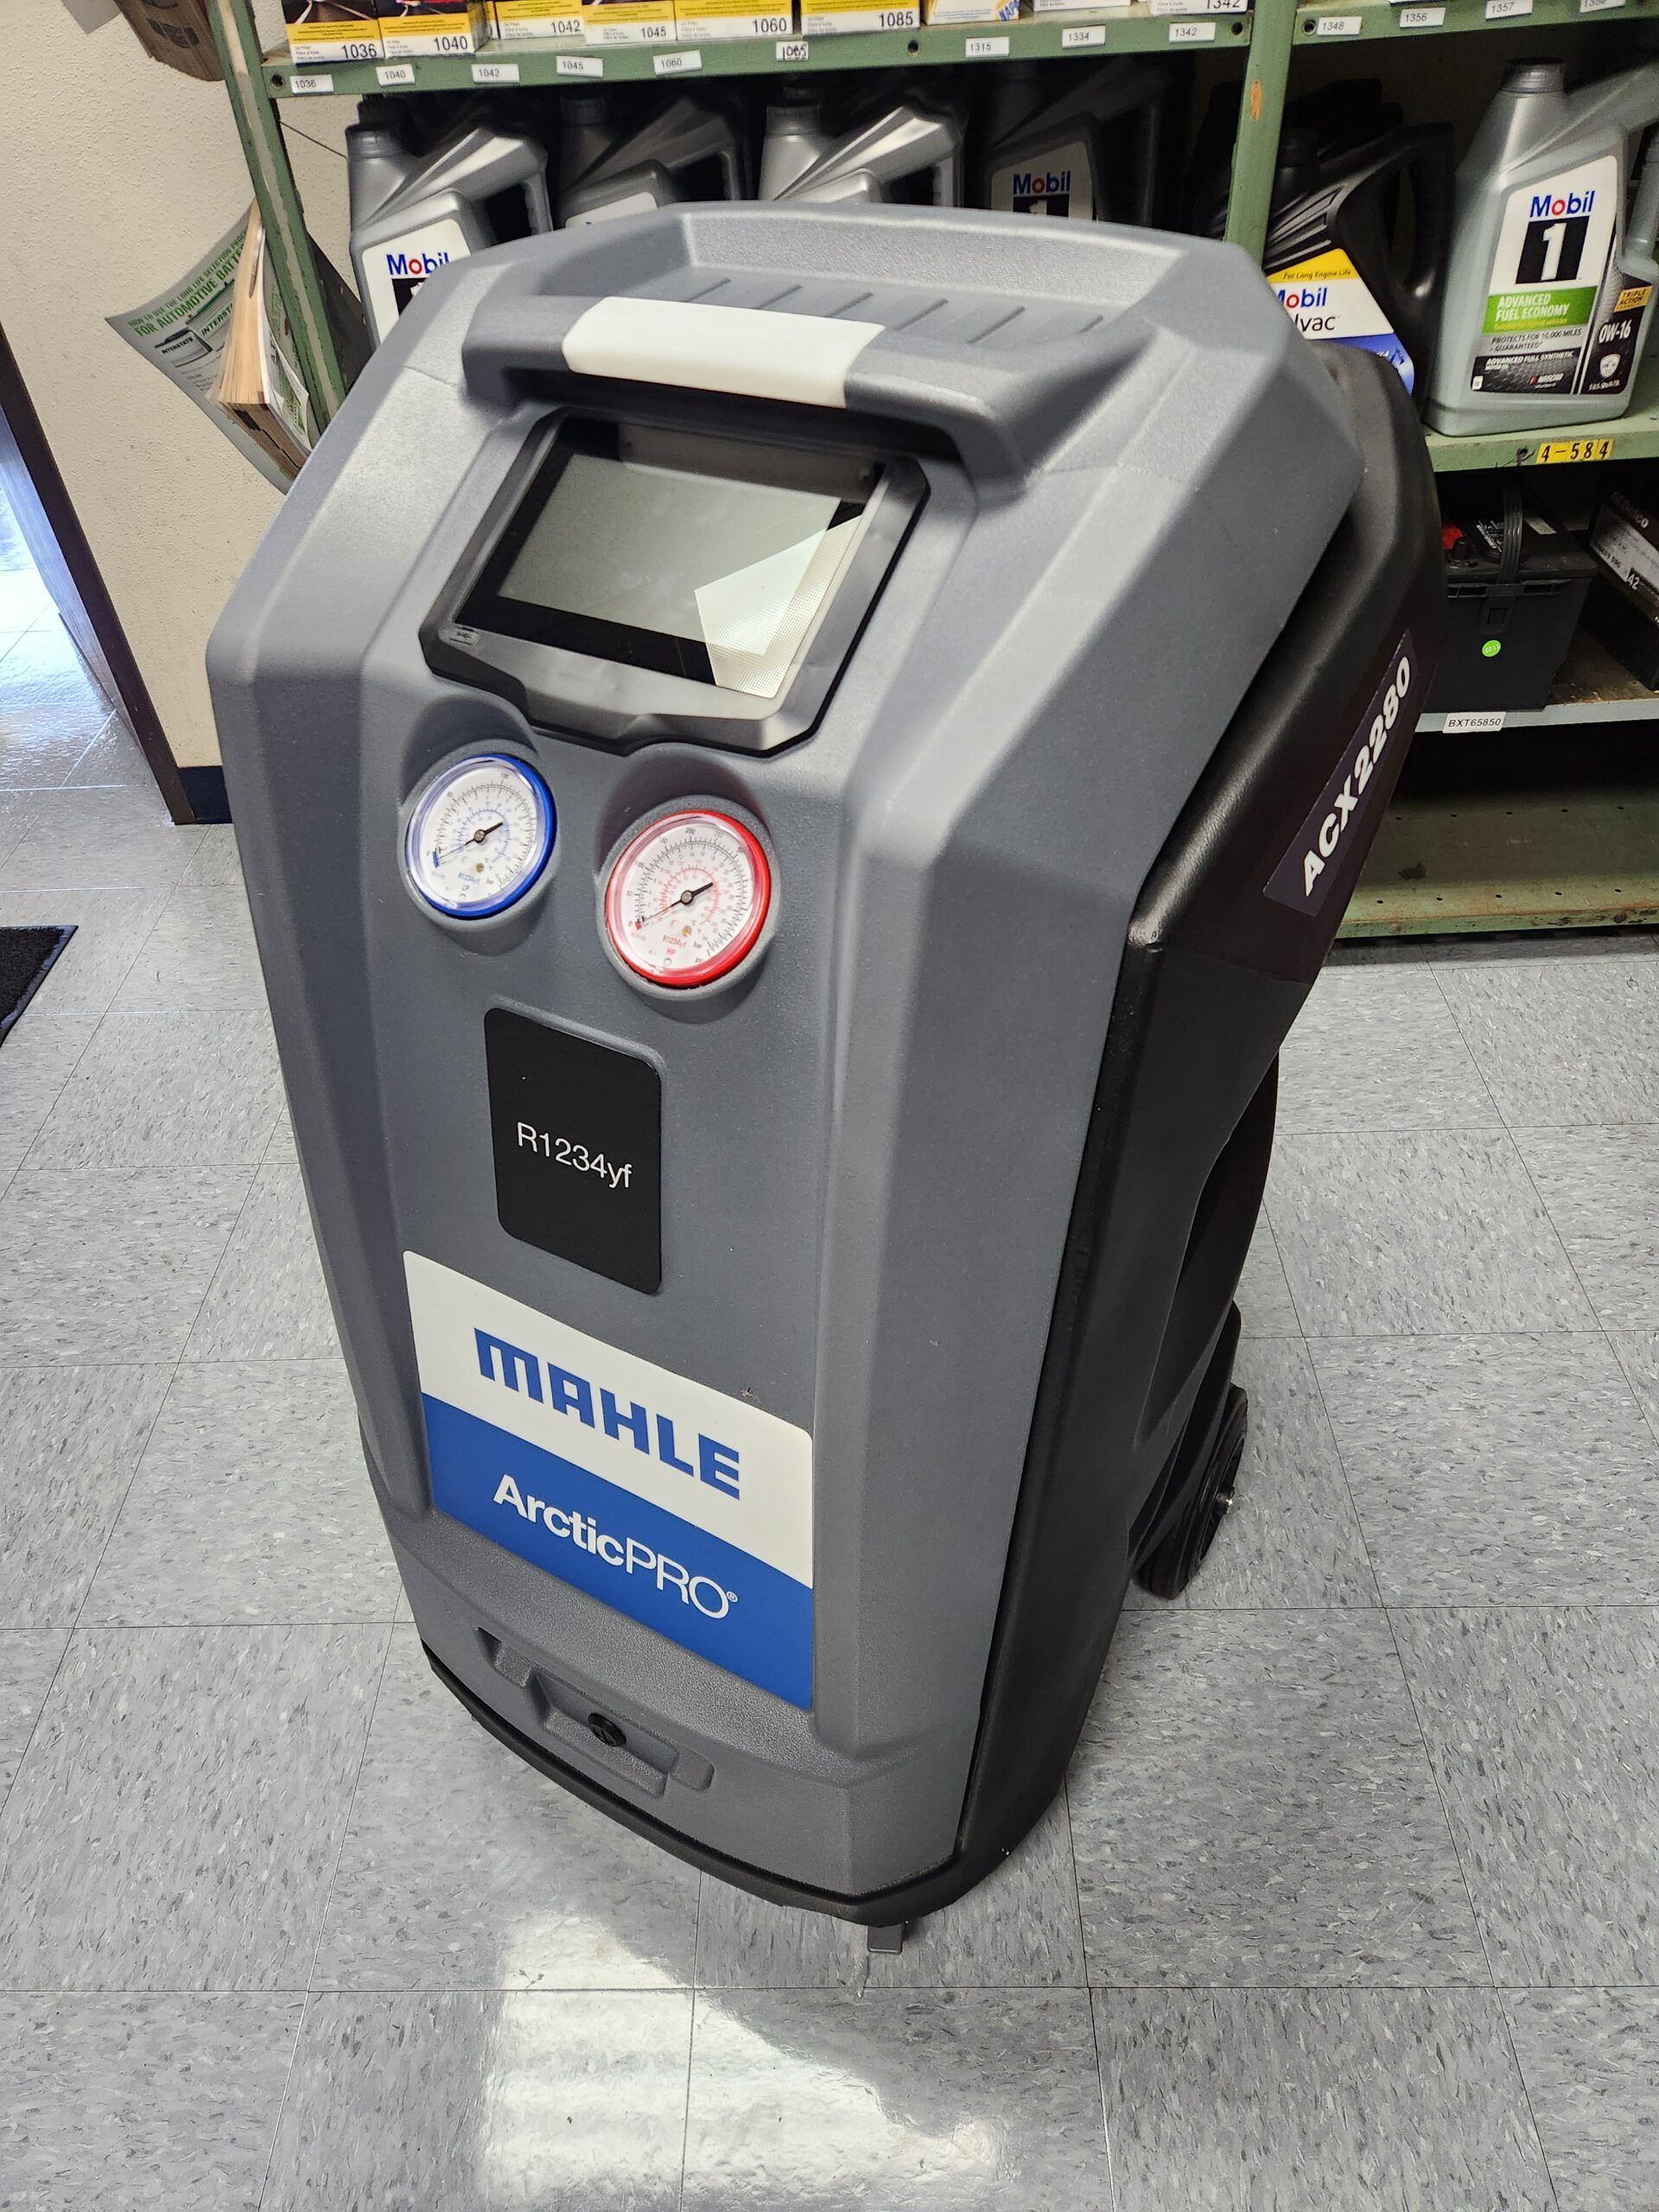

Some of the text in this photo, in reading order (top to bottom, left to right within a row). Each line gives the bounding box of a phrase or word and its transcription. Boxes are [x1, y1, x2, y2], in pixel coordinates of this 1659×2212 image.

[1492, 3, 1515, 14] 1357
[879, 11, 913, 28] 1085
[1406, 12, 1427, 22] 1356
[550, 19, 581, 35] 1042
[641, 26, 667, 38] 1045
[753, 17, 787, 34] 1060
[1175, 28, 1198, 37] 1342
[1323, 21, 1344, 30] 1348
[434, 35, 468, 51] 1040
[1069, 31, 1090, 42] 1334
[341, 43, 378, 59] 1036
[562, 60, 584, 70] 1045
[661, 58, 683, 69] 1060
[385, 69, 406, 80] 1040
[479, 68, 500, 78] 1042
[295, 79, 317, 89] 1036
[1013, 170, 1071, 194] Mobil
[1529, 190, 1595, 218] Mobil
[1541, 222, 1567, 281] 1
[1314, 270, 1337, 279] Engine
[135, 244, 244, 337] FOR AUTOMOTIVE BATTE
[1497, 294, 1552, 310] ADVANCED
[1496, 303, 1570, 322] FUEL ECONOMY
[1491, 334, 1525, 344] PROTECTS
[1599, 319, 1632, 344] 0W-16
[1448, 718, 1502, 728] BXT65850
[1303, 656, 1410, 898] ACX2280
[518, 1122, 632, 1188] R1234yf
[474, 1327, 741, 1500] MAHLE
